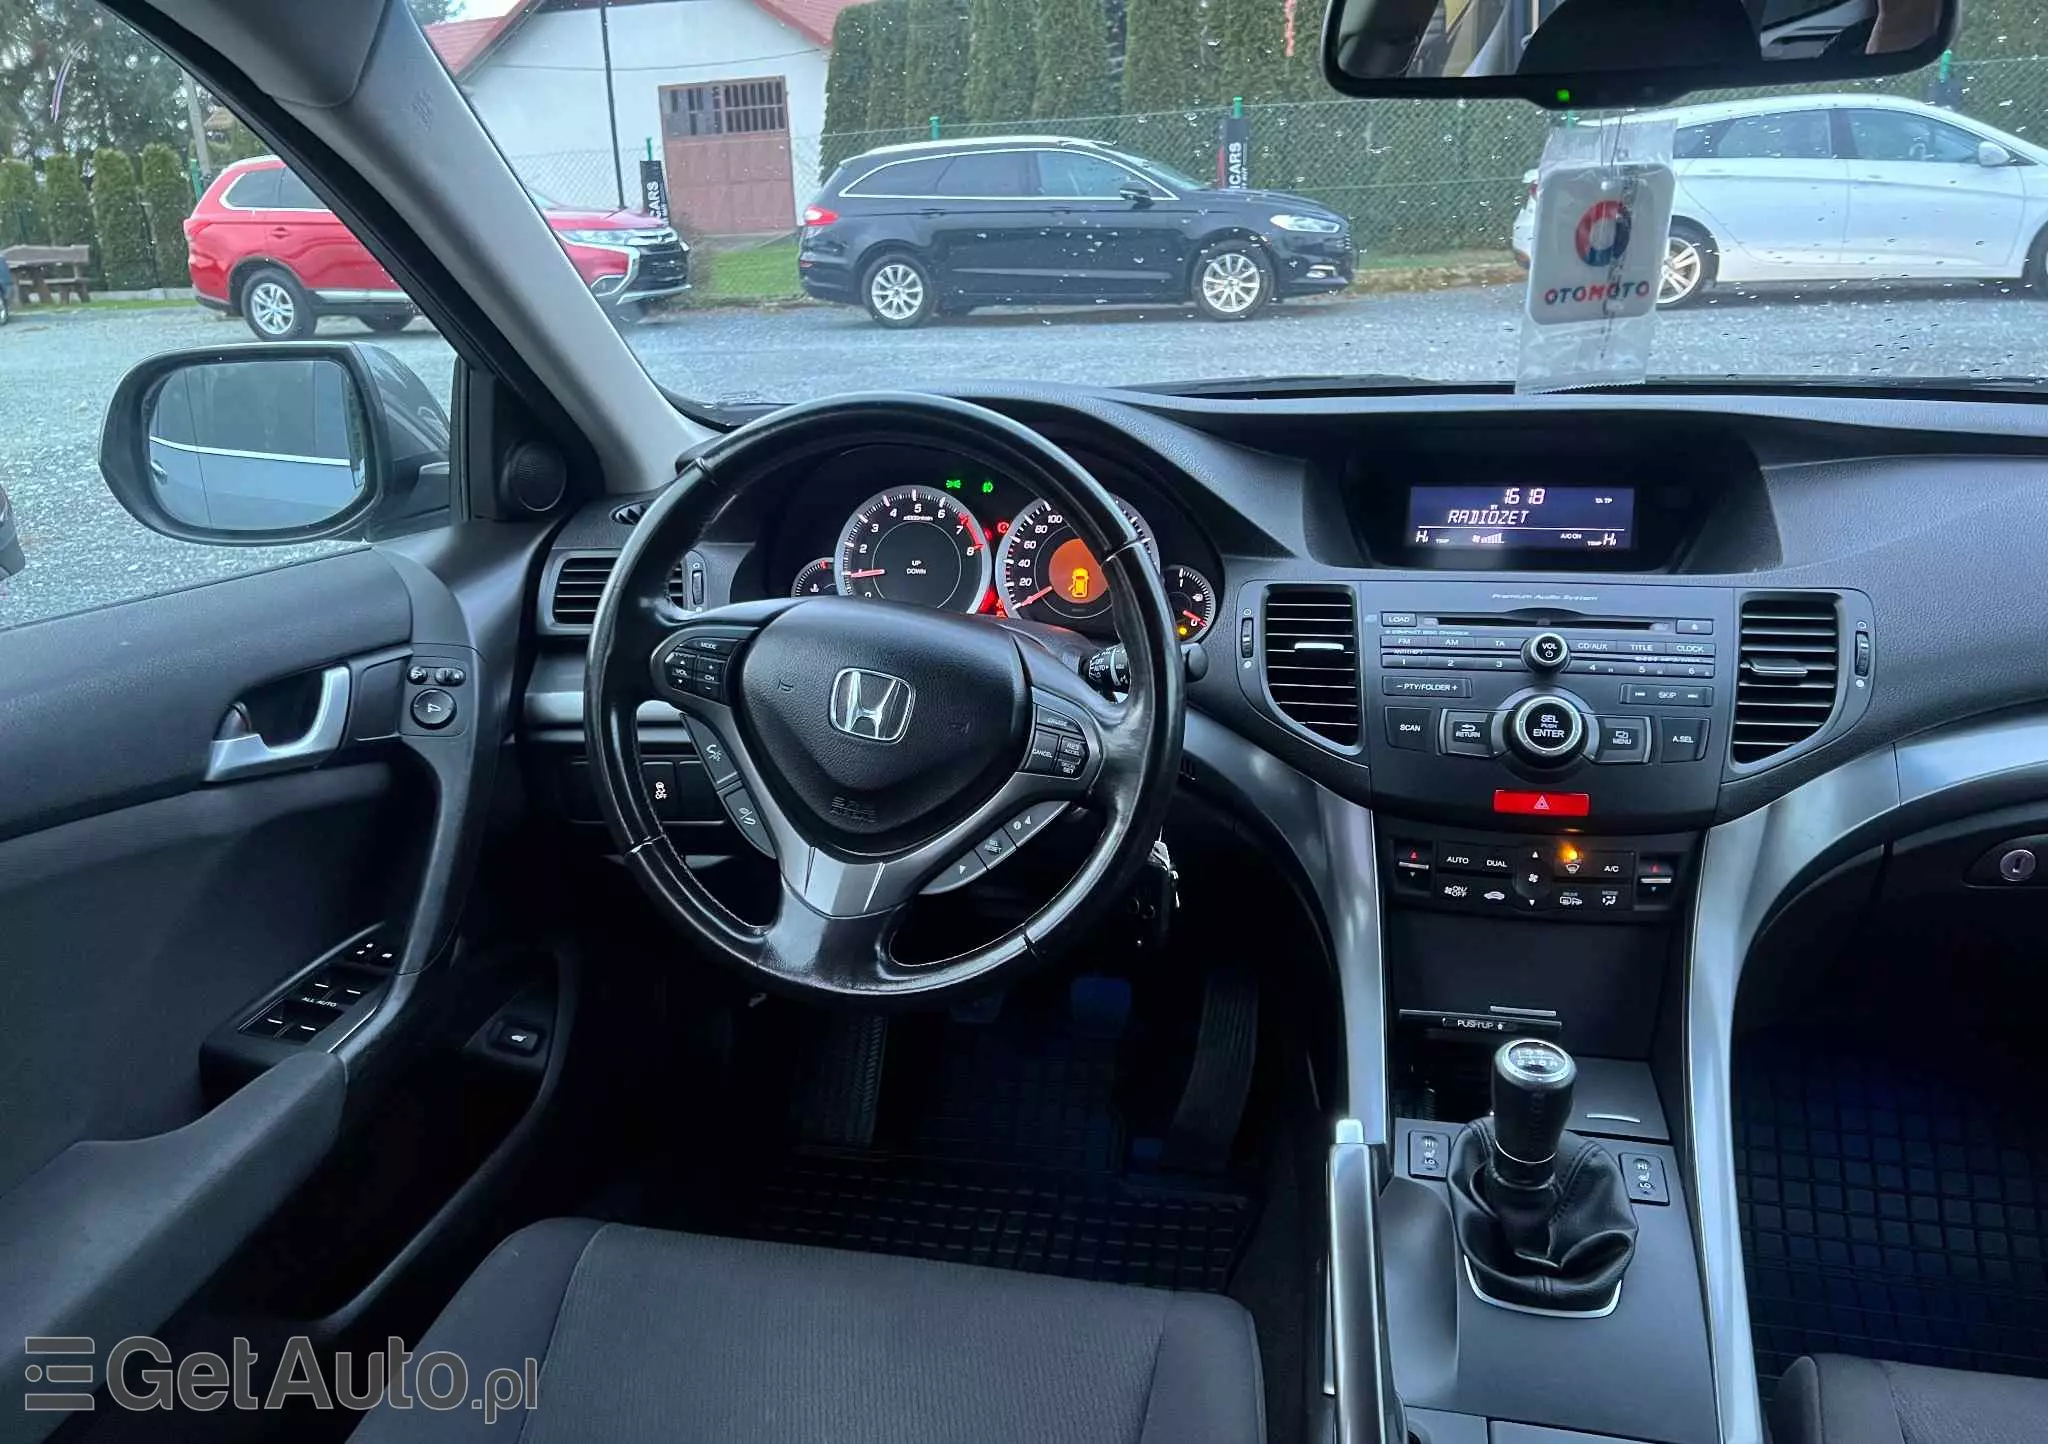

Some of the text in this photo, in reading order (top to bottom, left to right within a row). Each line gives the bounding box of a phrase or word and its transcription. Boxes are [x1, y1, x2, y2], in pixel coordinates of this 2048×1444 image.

[1544, 280, 1660, 306] OTOMOTO
[914, 503, 922, 513] 5
[889, 508, 898, 518] 4
[937, 509, 946, 519] 6
[1047, 514, 1063, 523] 100
[871, 523, 879, 533] 3
[955, 525, 964, 535] 7
[1034, 524, 1048, 533] 80
[859, 543, 868, 553] 2
[1023, 540, 1037, 549] 60
[966, 546, 975, 556] 8
[1018, 559, 1031, 567] 40
[1019, 577, 1032, 586] 20
[1388, 615, 1411, 624] LOAD
[1445, 639, 1459, 647] AM
[1541, 642, 1558, 650] VOL
[1676, 645, 1705, 653] CLOCK
[1403, 683, 1451, 692] PTY/FOLDER
[1658, 691, 1677, 699] SKIP
[1541, 714, 1559, 723] SEL
[1400, 724, 1421, 732] SCAN
[1455, 730, 1481, 738] RETURN
[1533, 729, 1565, 738] ENTER
[1032, 749, 1054, 758] CANCEL
[1446, 856, 1469, 864] AUTO
[1486, 859, 1508, 868] DUAL
[1604, 865, 1619, 873] A/C
